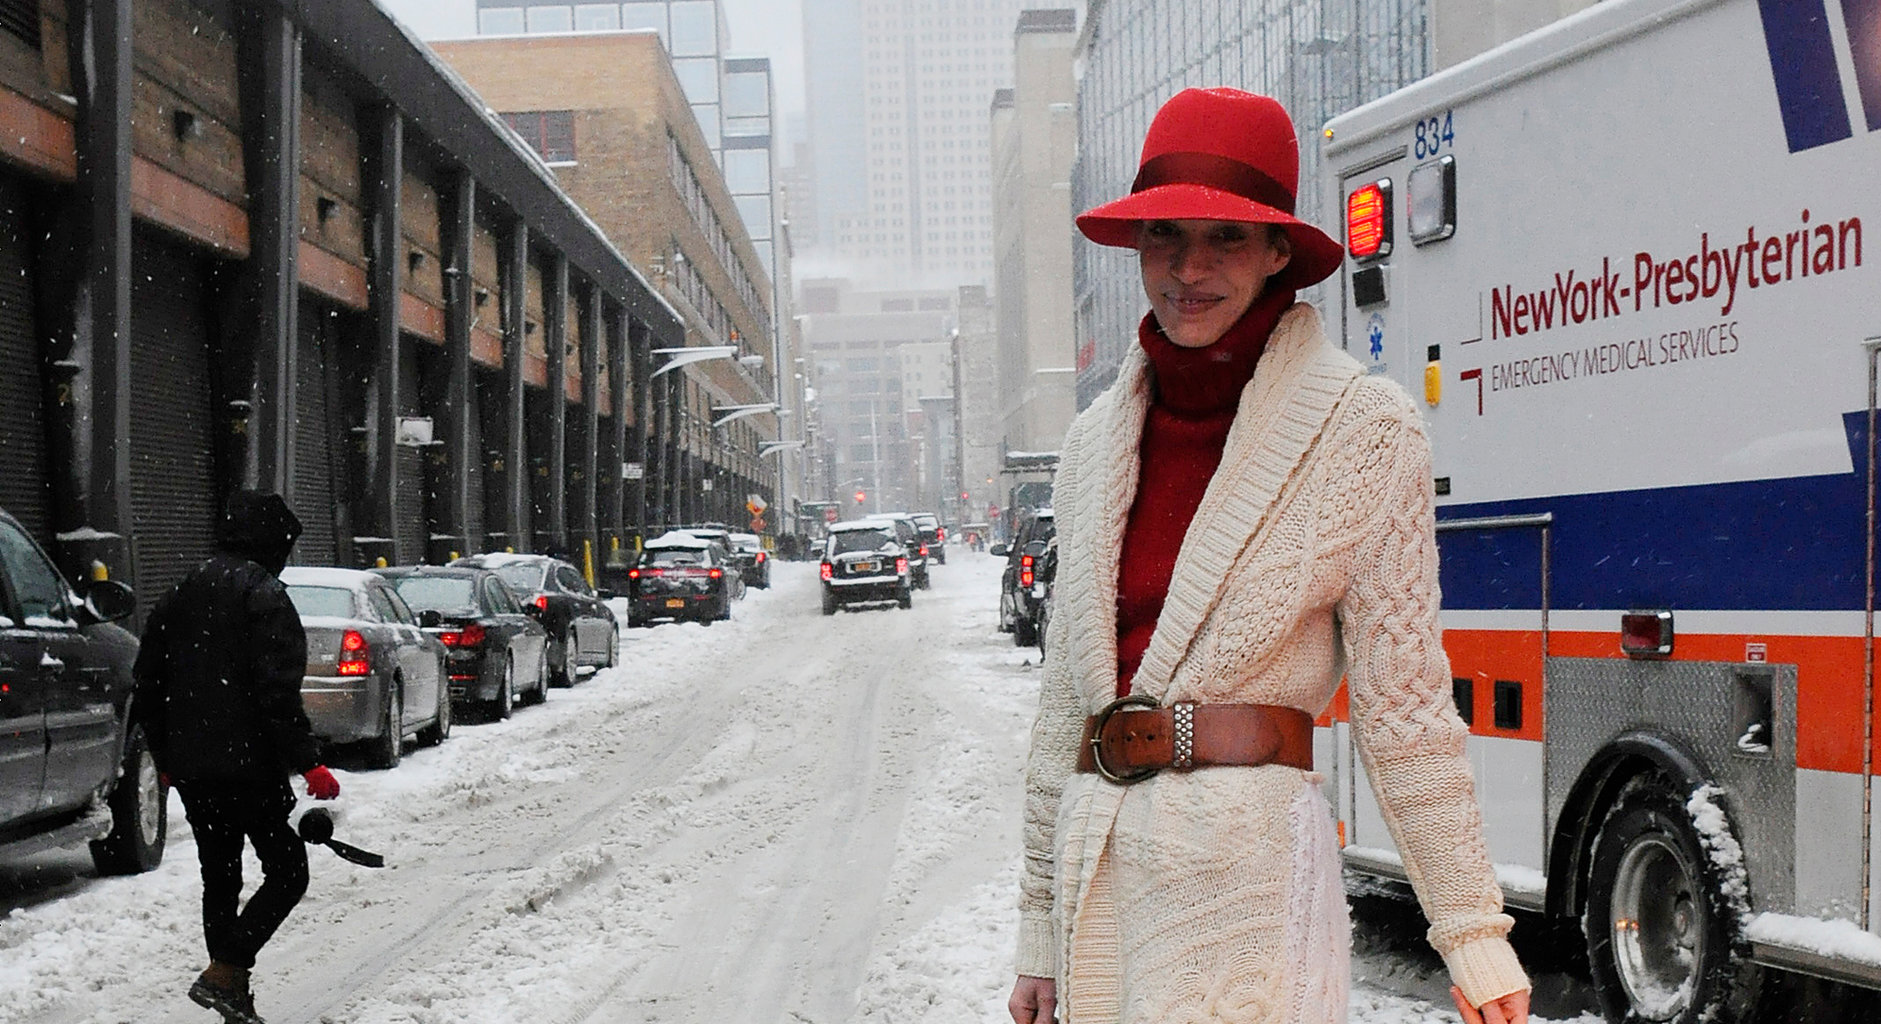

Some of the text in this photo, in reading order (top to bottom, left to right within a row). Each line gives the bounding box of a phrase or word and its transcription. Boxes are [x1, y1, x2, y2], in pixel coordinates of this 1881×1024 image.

[1415, 109, 1454, 160] 834
[1492, 208, 1862, 341] NewYork-Presbyterian
[1492, 321, 1739, 391] EMERGENCY MEDICAL SERVICES
